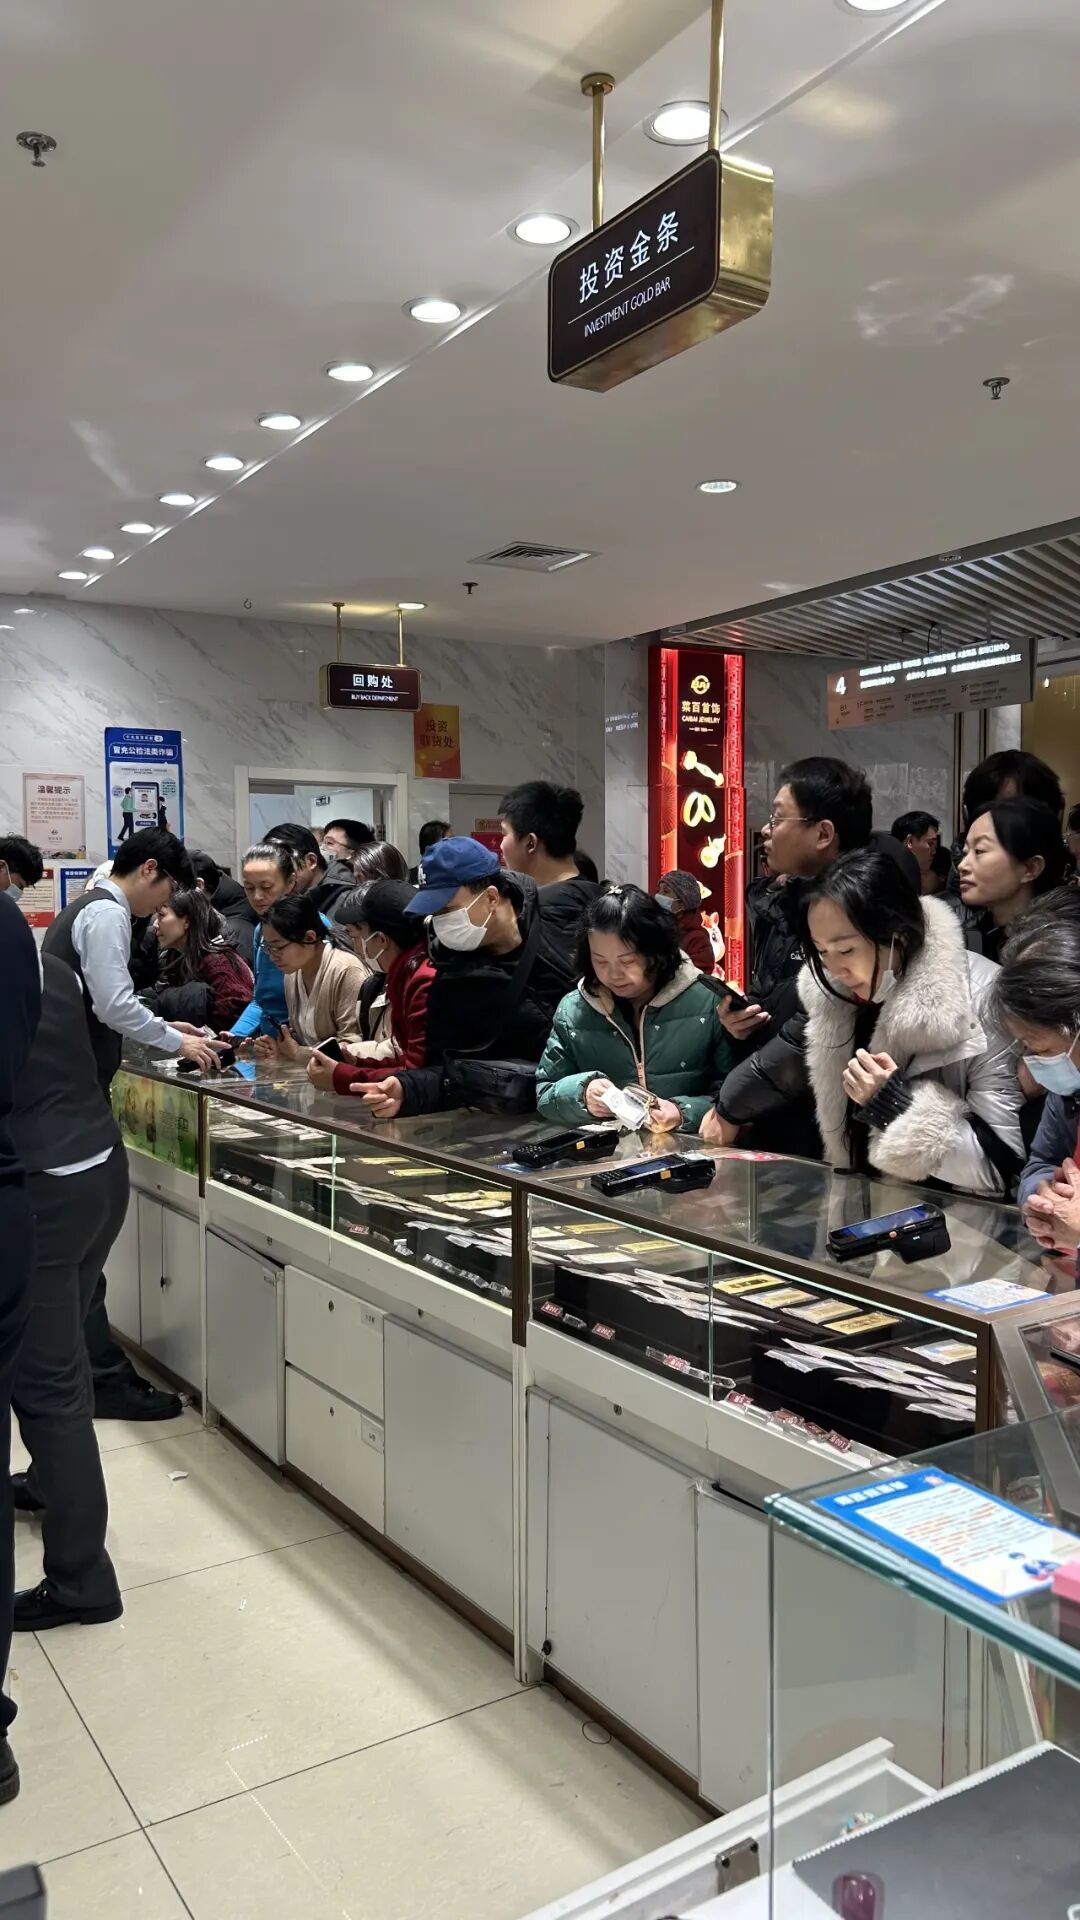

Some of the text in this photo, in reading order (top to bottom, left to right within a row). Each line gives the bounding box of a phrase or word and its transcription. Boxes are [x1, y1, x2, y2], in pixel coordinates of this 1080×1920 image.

[579, 211, 679, 304] 投资金条
[584, 276, 671, 338] INVESTMENT GOLD BAR
[352, 674, 394, 689] 回购处
[835, 676, 847, 695] 4
[681, 700, 721, 714] 菜百首饰
[425, 719, 448, 732] 投资
[37, 785, 71, 794] 温馨提示
